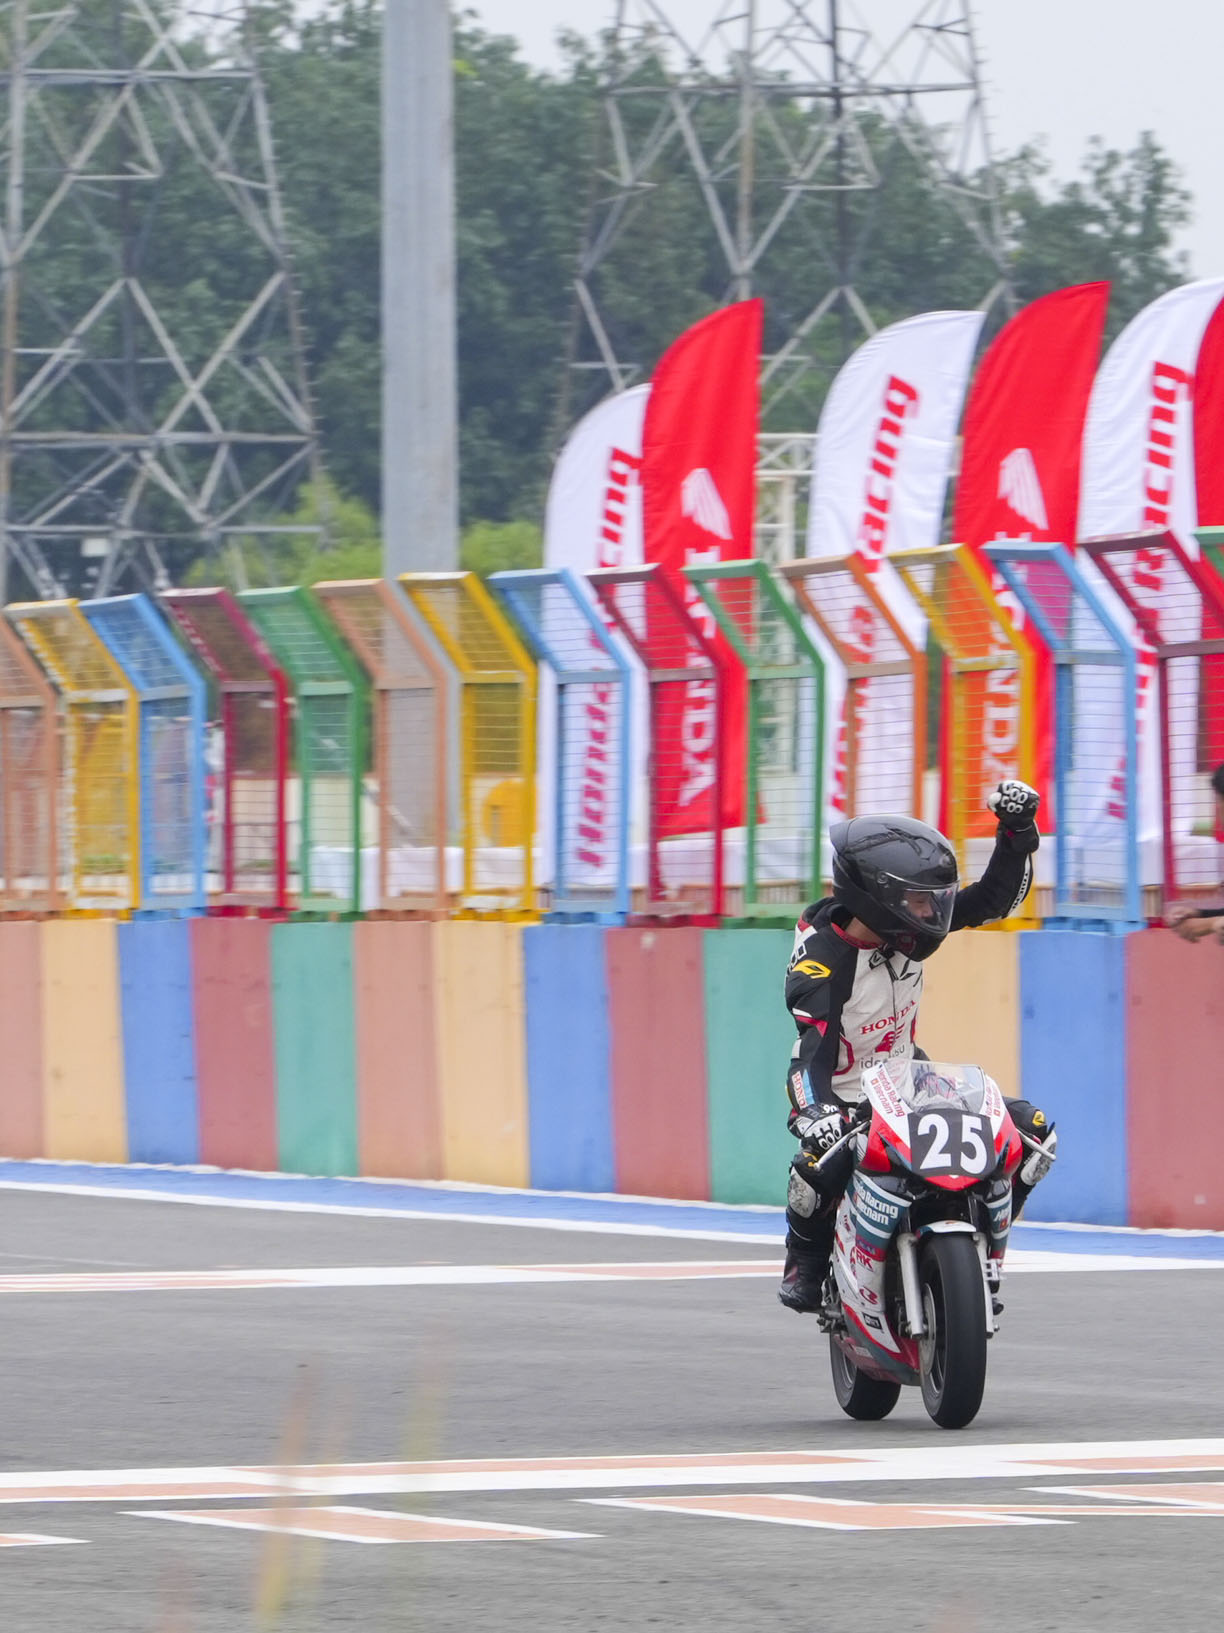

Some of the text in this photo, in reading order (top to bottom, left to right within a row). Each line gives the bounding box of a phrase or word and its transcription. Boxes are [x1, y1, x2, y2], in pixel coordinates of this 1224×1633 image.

[587, 448, 642, 653] cing
[861, 1000, 916, 1035] HONDA
[917, 1113, 988, 1175] 25
[865, 1191, 899, 1219] Racing
